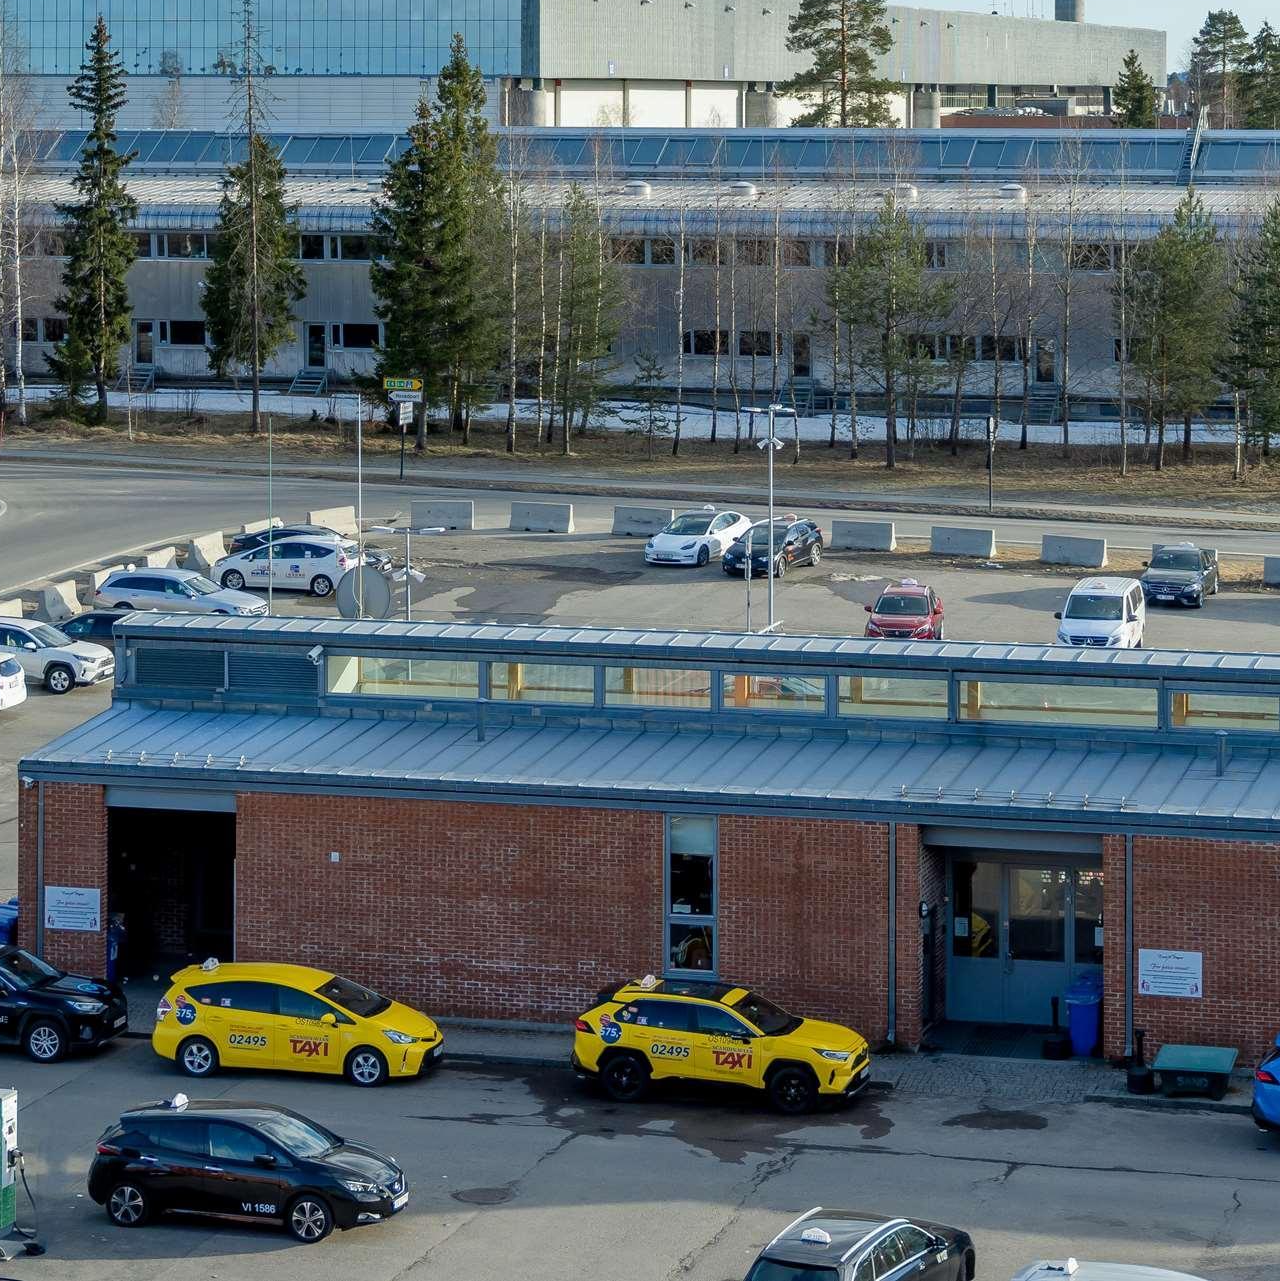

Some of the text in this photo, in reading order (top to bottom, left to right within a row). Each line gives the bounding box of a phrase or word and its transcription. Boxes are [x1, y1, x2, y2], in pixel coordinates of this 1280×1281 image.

[229, 1033, 267, 1047] 02495
[289, 1039, 329, 1057] TAXI
[651, 1043, 690, 1058] 02495
[712, 1050, 753, 1070] TAXI
[241, 1202, 276, 1214] VI 1586
